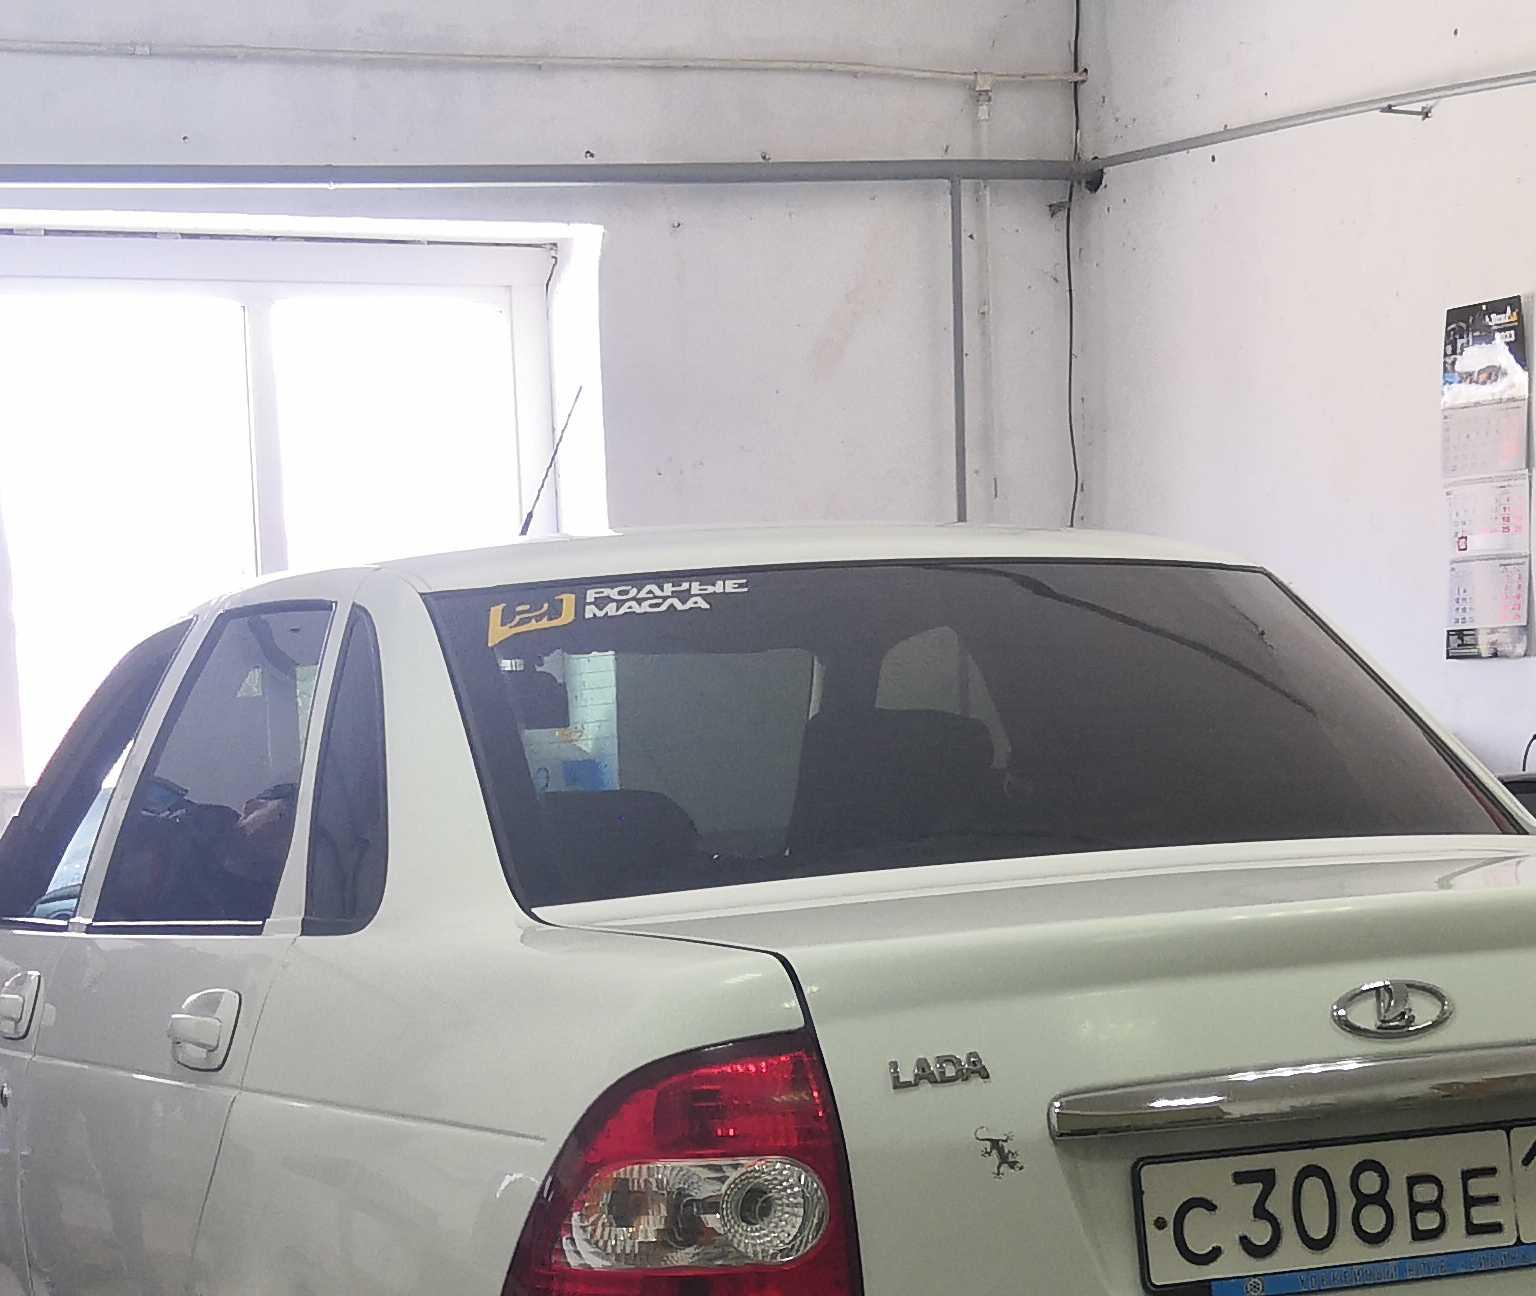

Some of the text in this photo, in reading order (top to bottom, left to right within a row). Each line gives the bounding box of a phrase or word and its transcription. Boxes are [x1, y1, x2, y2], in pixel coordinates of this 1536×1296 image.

[585, 579, 748, 602] РОДНЫЕ
[584, 596, 710, 619] МАСЛА
[889, 1051, 990, 1090] LADA
[1172, 1159, 1504, 1266] С308ВЕ
